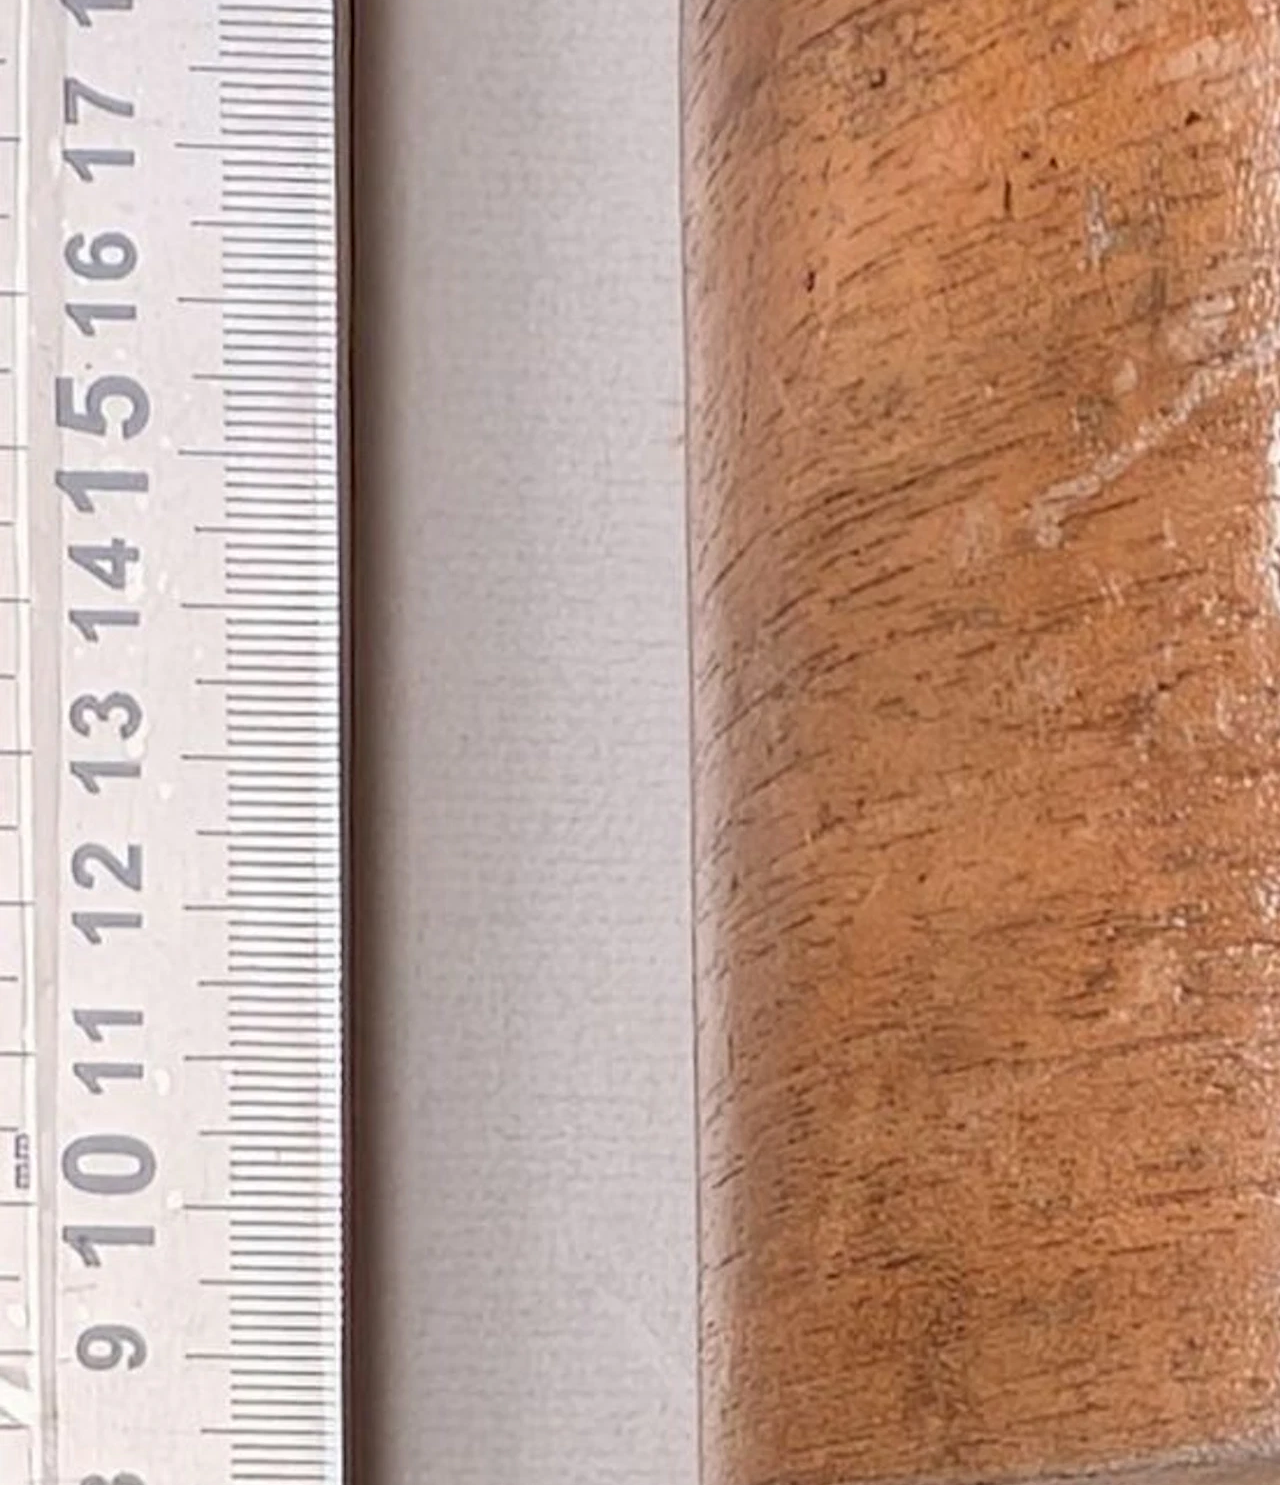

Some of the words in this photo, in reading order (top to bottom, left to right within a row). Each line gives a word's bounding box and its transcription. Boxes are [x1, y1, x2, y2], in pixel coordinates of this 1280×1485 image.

[60, 74, 136, 184] 17
[62, 231, 138, 338] 16
[53, 375, 151, 515] 15
[66, 537, 142, 644] 14
[68, 690, 144, 796] 13
[70, 842, 144, 946] 12
[71, 1008, 145, 1096] 11
[60, 1134, 156, 1269] 10
[75, 1324, 148, 1372] 9
